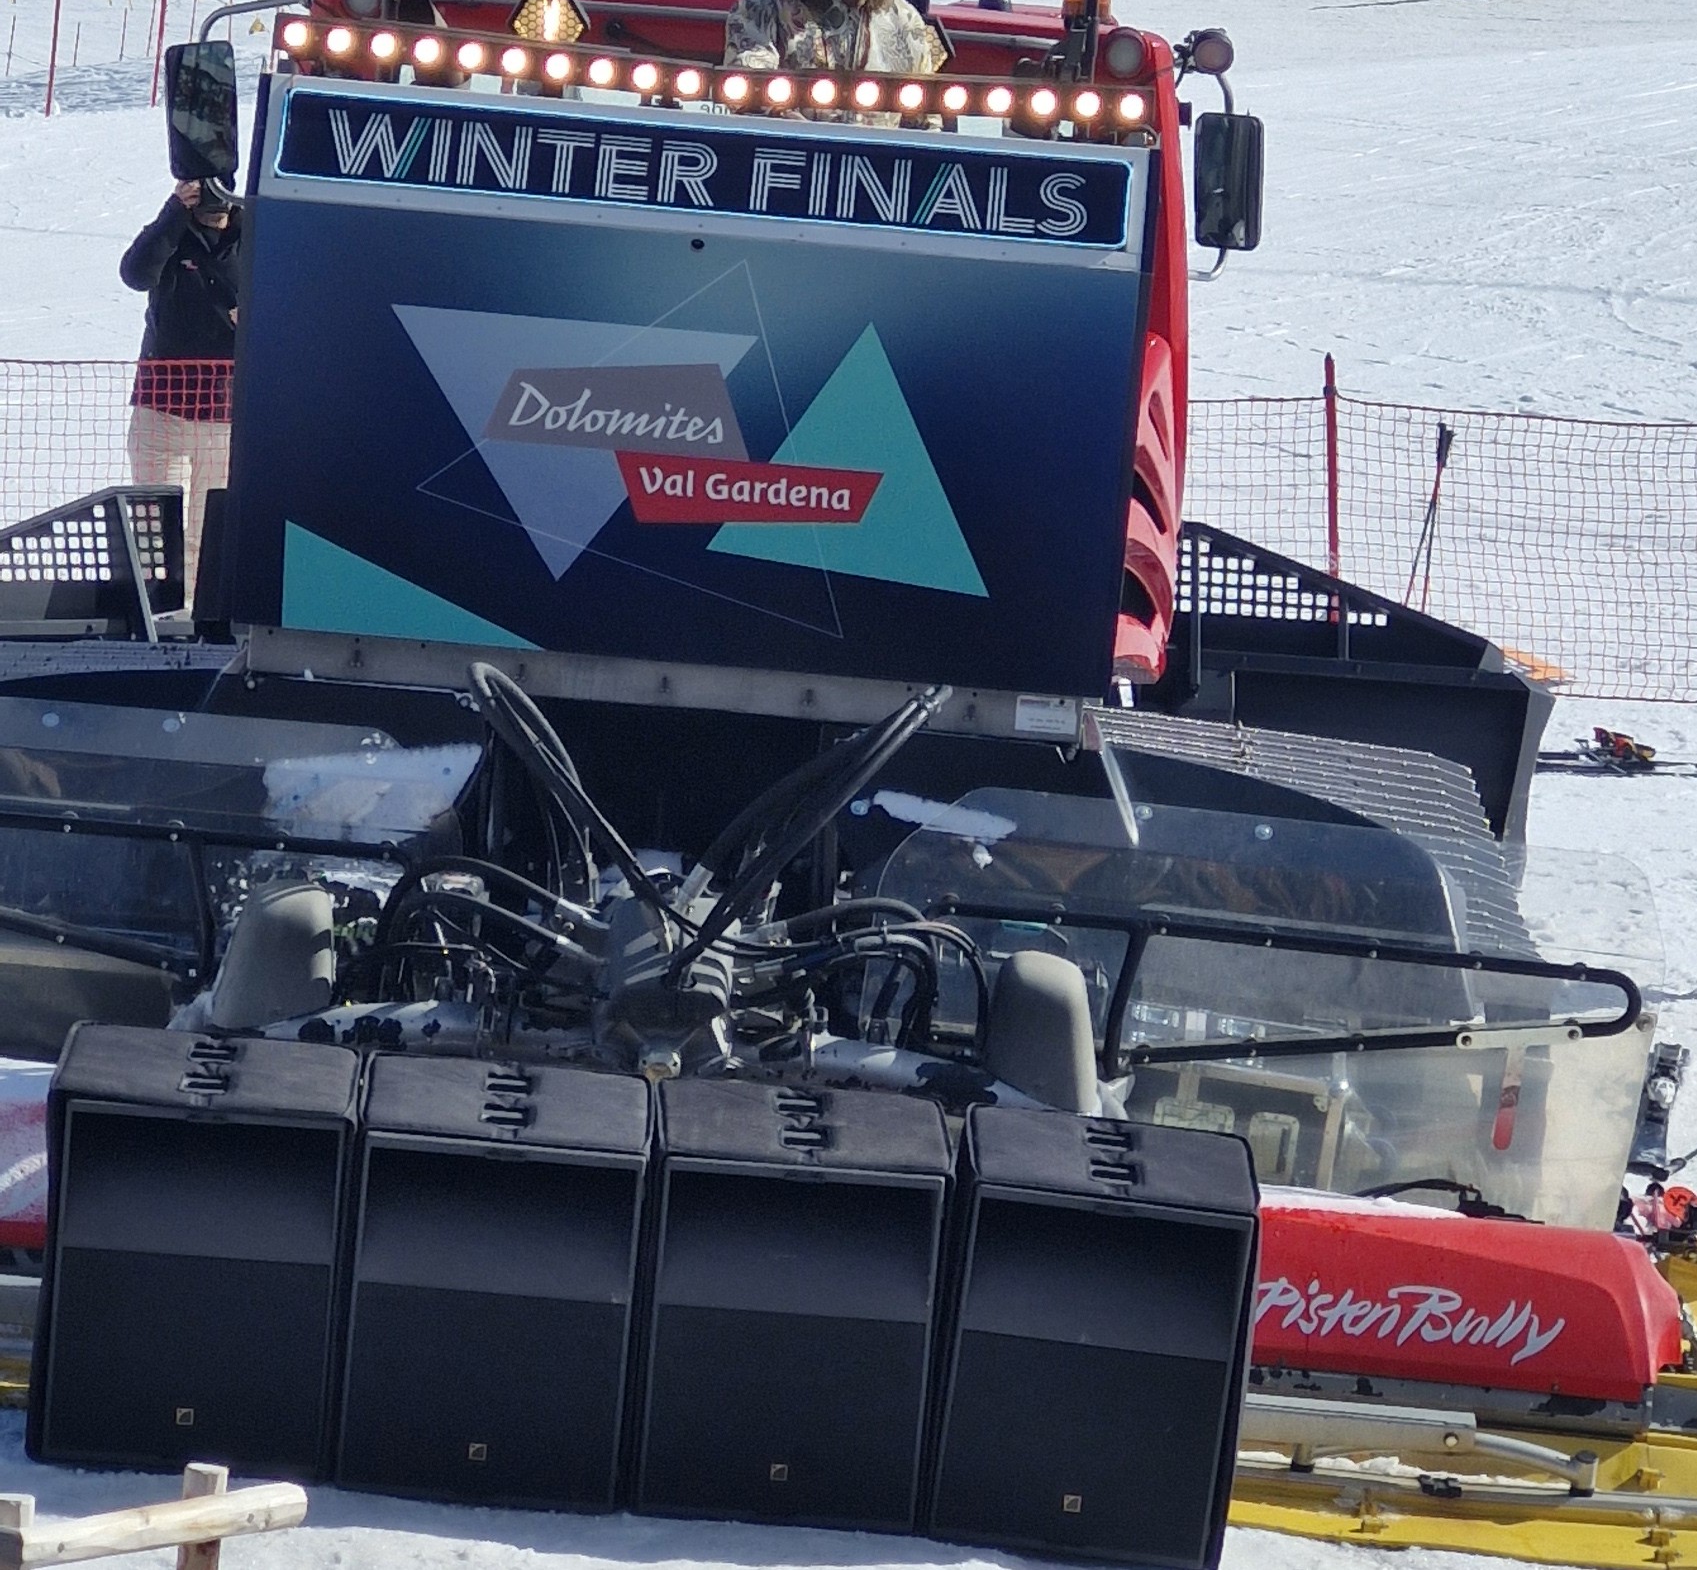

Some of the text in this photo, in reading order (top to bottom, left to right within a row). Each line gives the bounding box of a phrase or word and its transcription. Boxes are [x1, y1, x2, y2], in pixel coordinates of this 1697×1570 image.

[328, 108, 1089, 237] WINTER FINALS
[507, 381, 727, 446] Dolomites
[637, 466, 852, 512] Val Gardena
